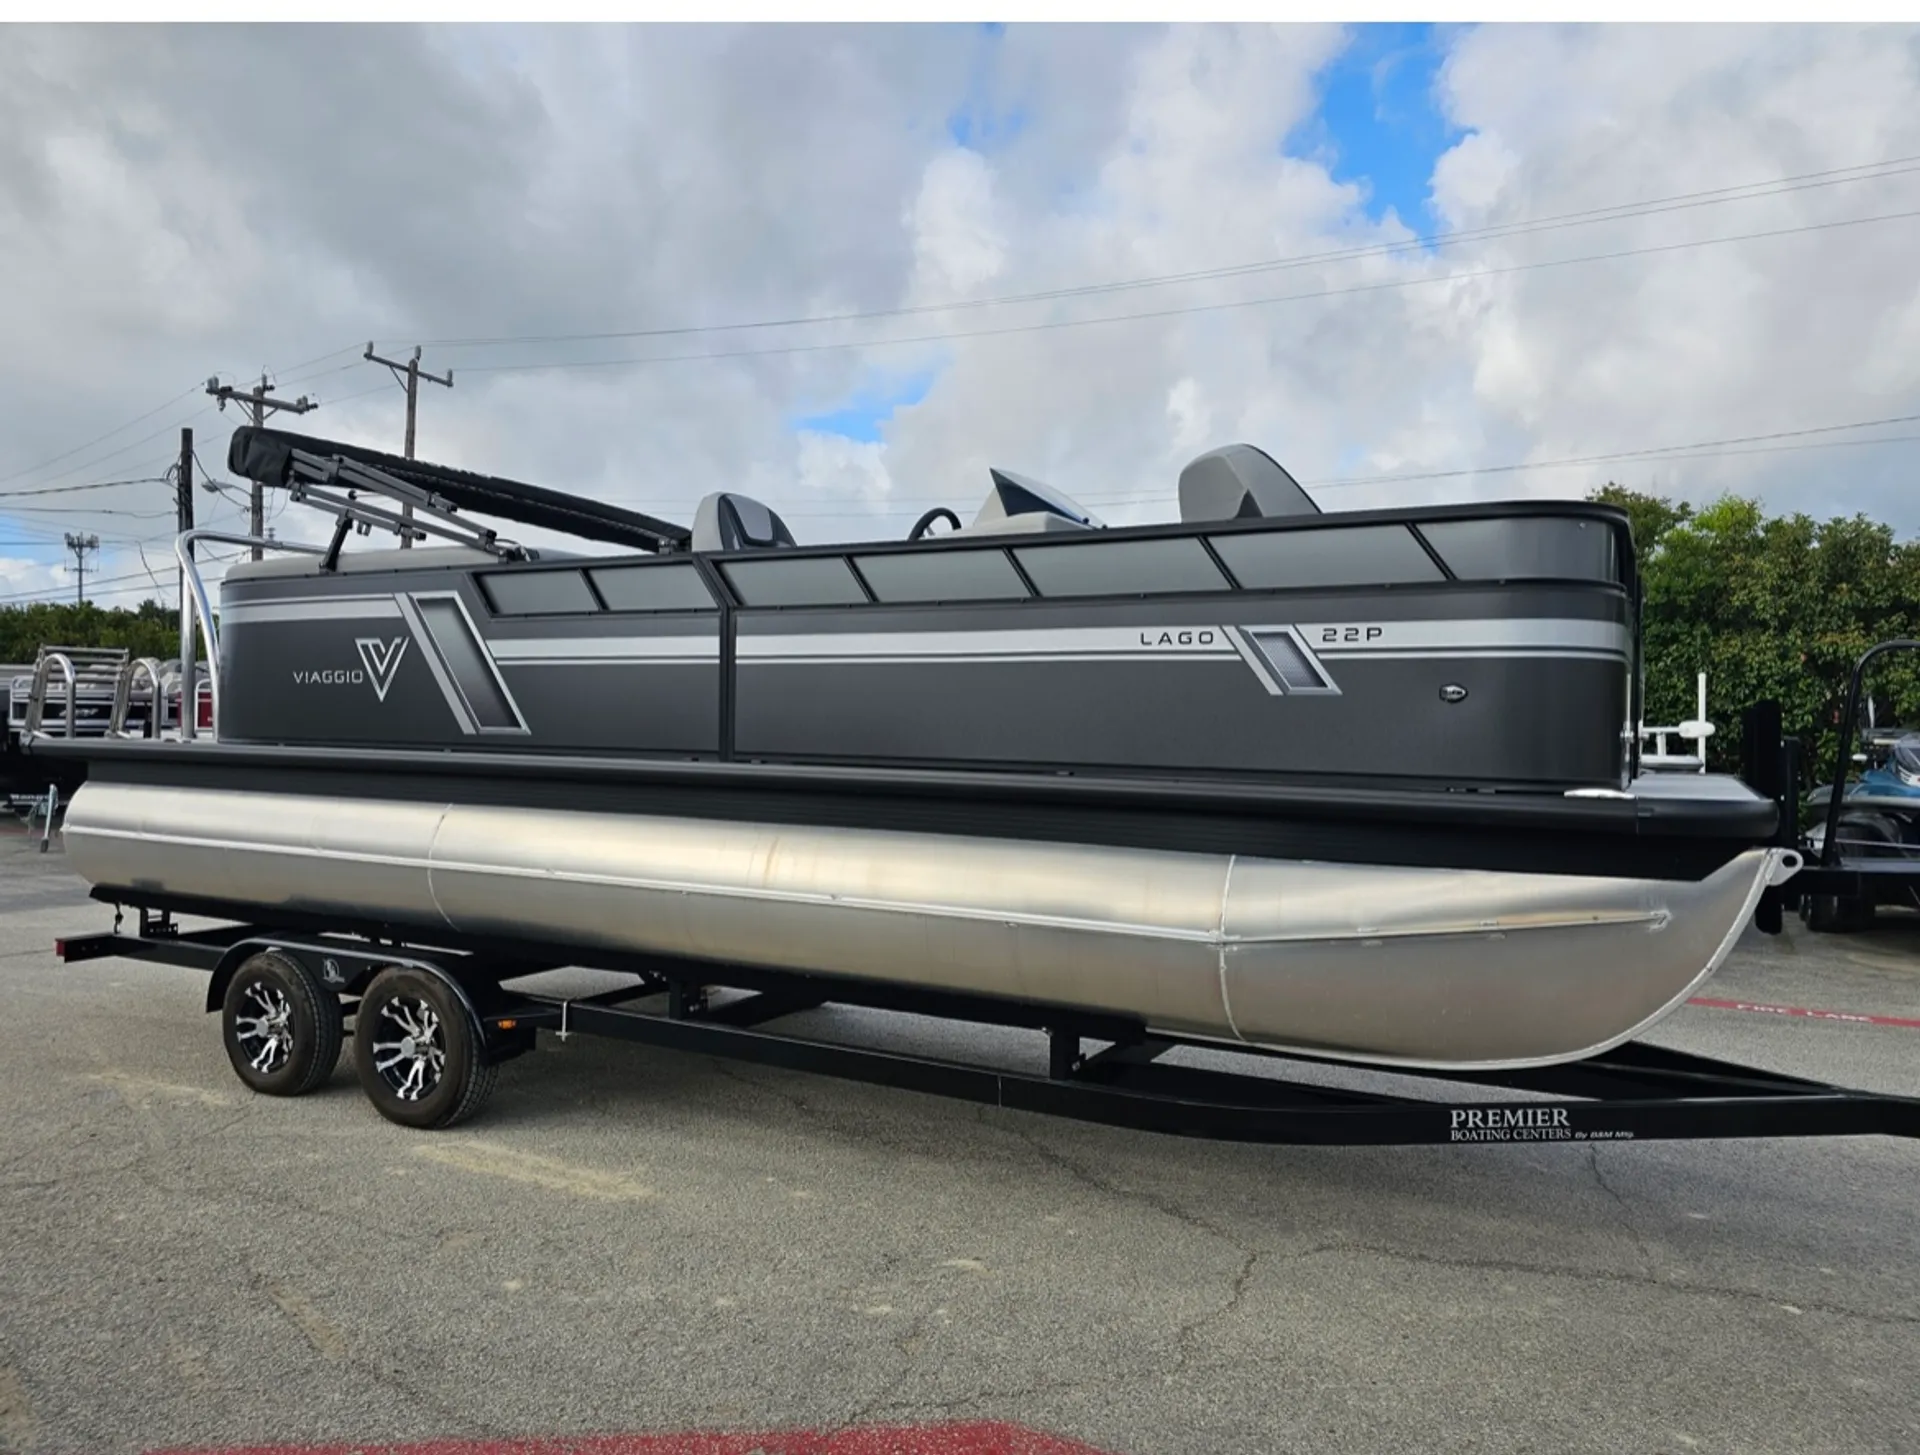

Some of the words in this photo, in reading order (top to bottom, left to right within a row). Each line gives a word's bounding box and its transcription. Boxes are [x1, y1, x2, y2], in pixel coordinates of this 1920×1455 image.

[1139, 631, 1214, 645] LAGO
[1322, 627, 1383, 642] 22P
[292, 670, 364, 684] VIAGGIO
[1450, 1108, 1571, 1128] PREMIER
[1450, 1129, 1511, 1141] BOATING
[1512, 1128, 1572, 1140] CENTERS
